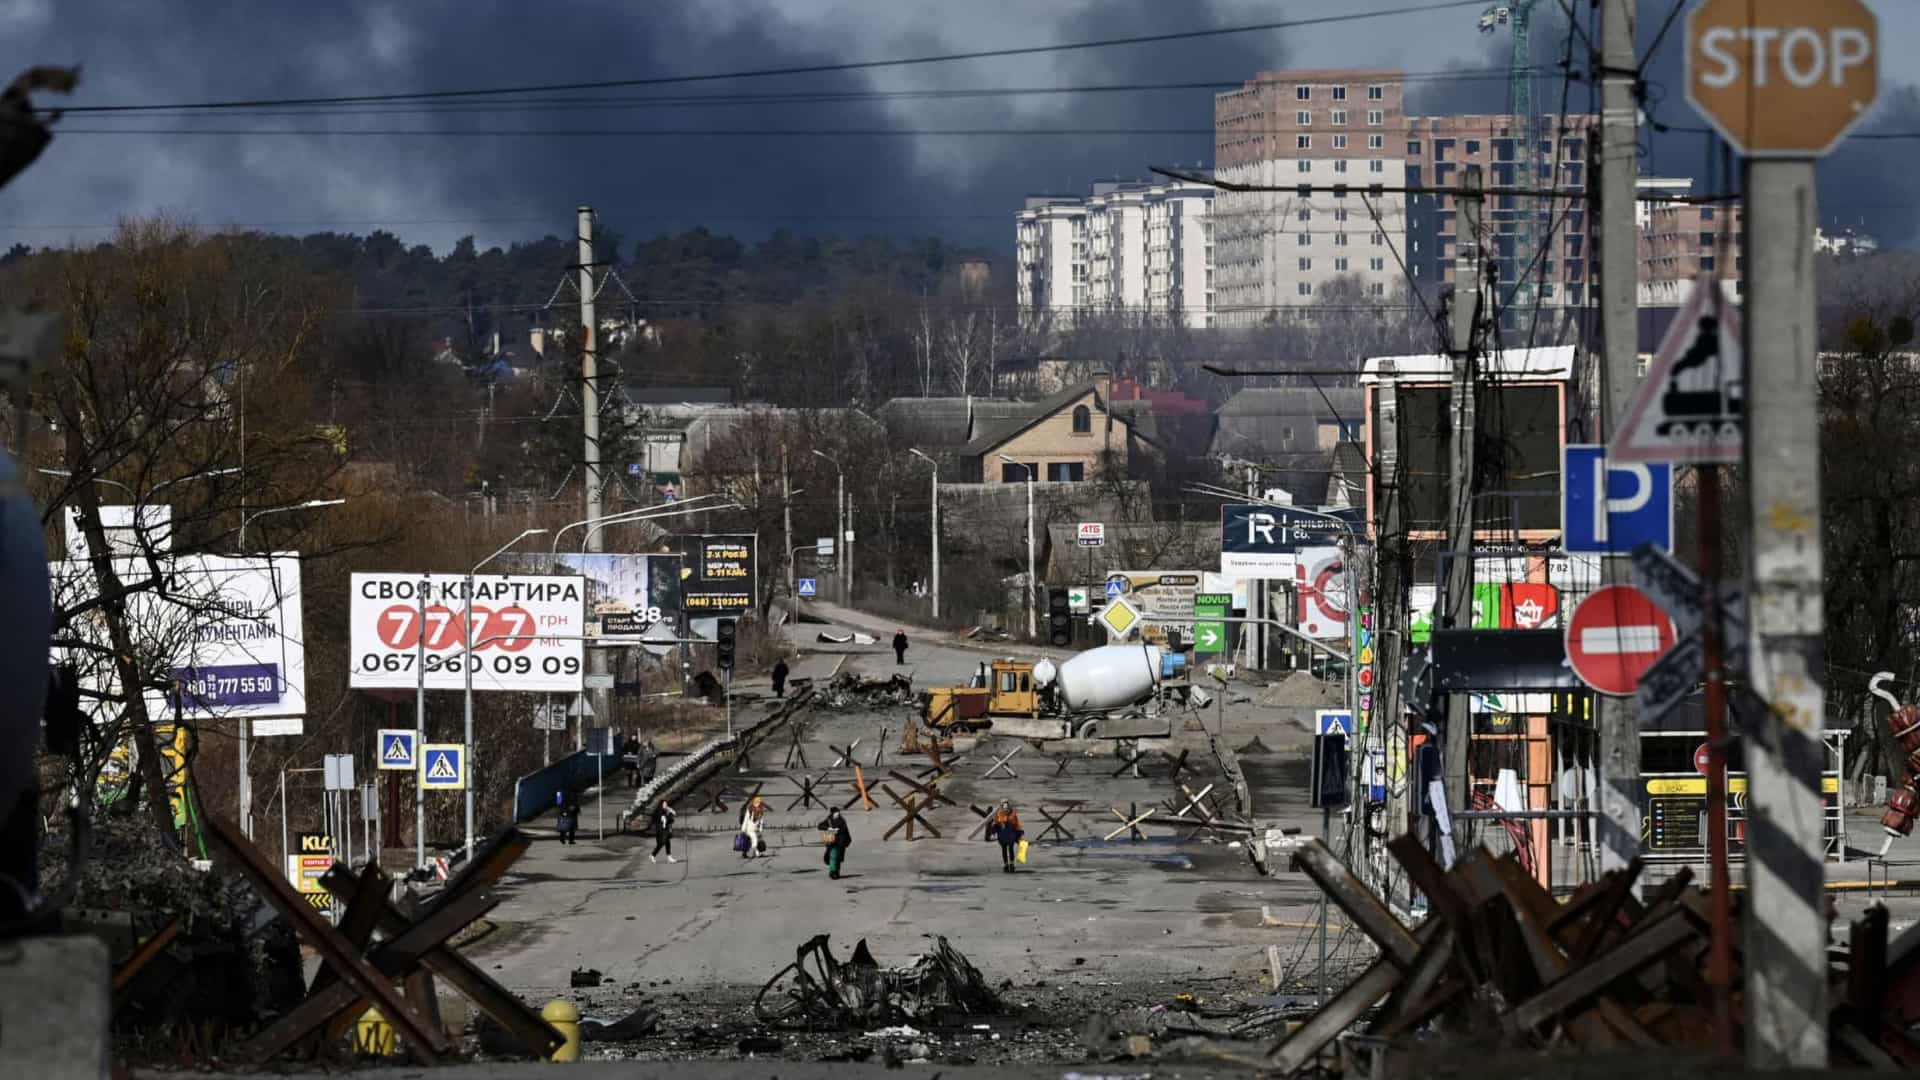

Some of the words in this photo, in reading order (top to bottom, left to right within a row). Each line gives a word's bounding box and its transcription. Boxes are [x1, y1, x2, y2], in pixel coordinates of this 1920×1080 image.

[1700, 27, 1871, 88] STOP
[1593, 457, 1652, 542] P
[361, 581, 431, 600] СВОЯ
[441, 582, 579, 602] КВАРТИРА
[1197, 596, 1231, 605] NOVUS
[541, 616, 568, 630] грн
[363, 654, 417, 672] 067
[425, 655, 483, 673] 960
[494, 656, 531, 673] 09
[542, 656, 580, 674] 09
[218, 680, 238, 693] 777
[241, 679, 256, 692] 55
[257, 677, 272, 692] 50
[302, 836, 337, 851] KLO
